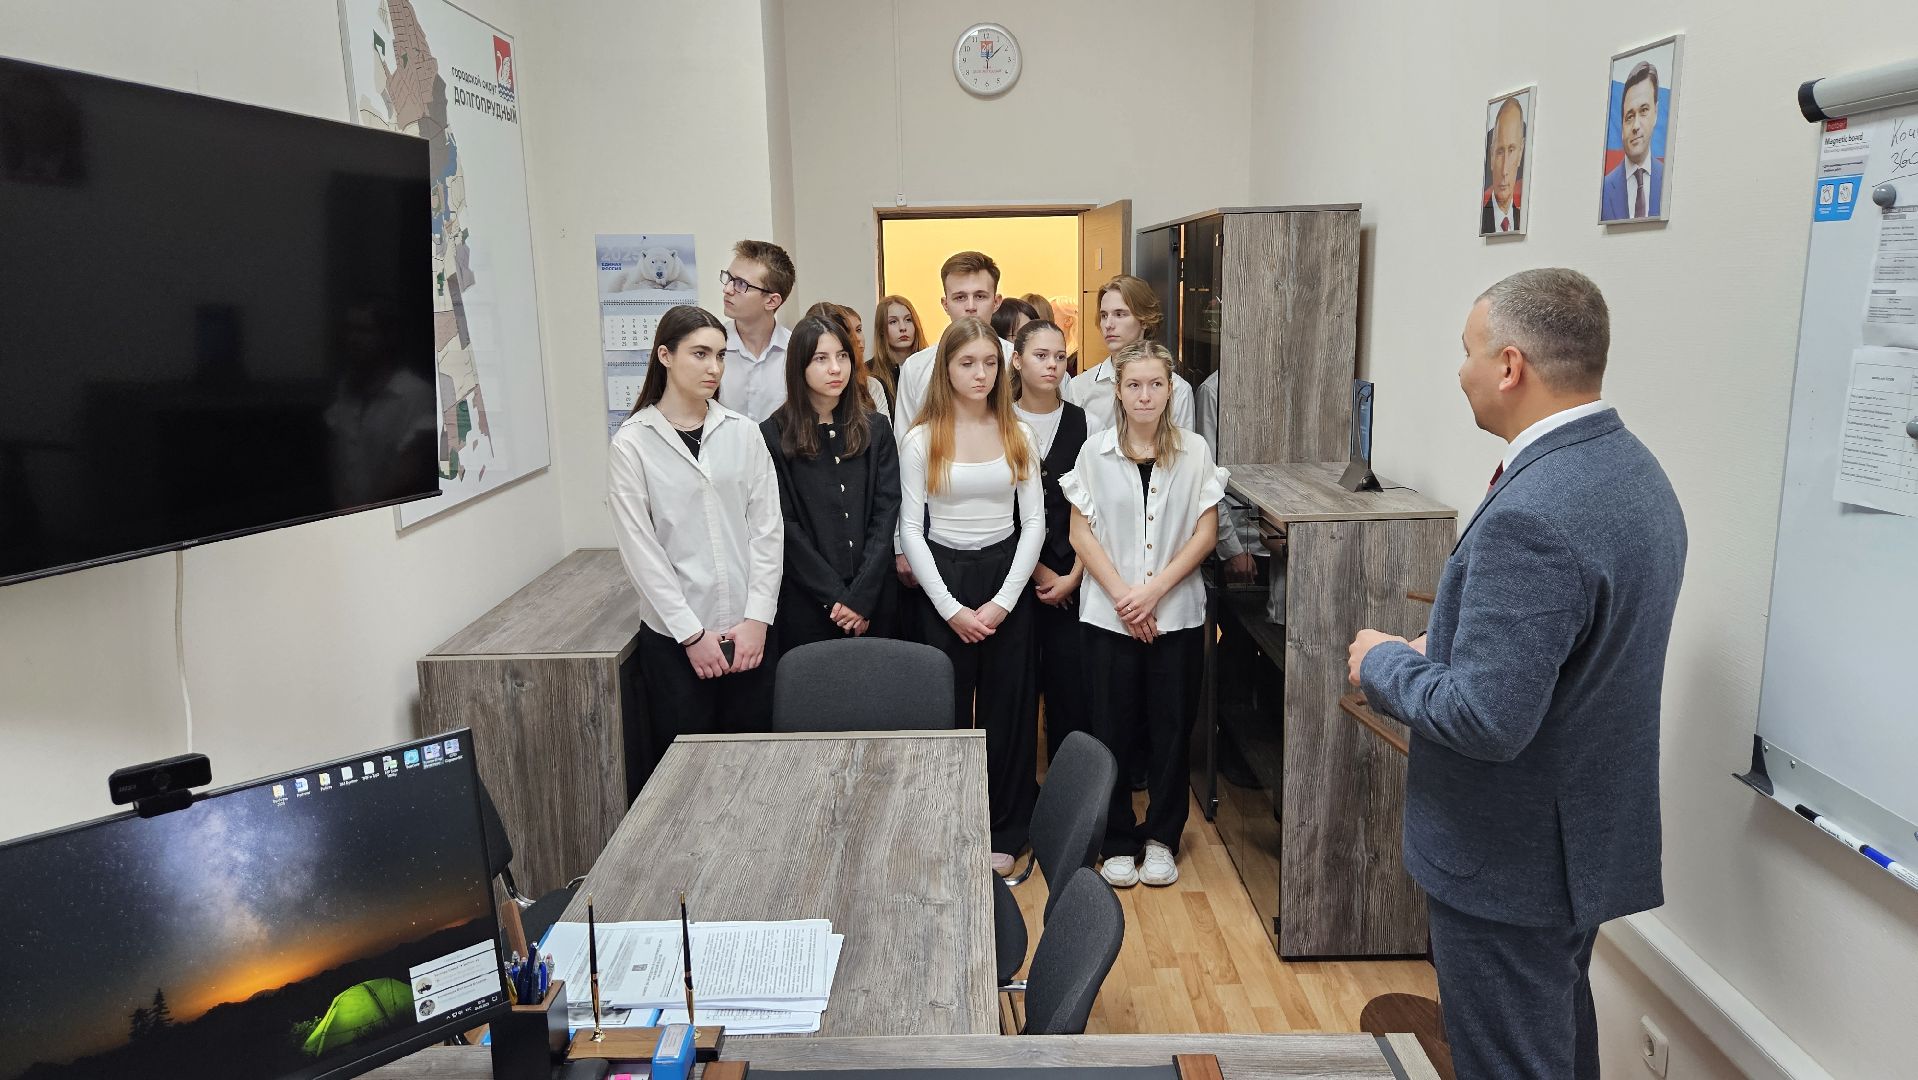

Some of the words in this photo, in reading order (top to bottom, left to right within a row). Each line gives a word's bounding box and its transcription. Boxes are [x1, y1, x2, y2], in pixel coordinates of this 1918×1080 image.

[451, 67, 482, 87] городской
[482, 80, 497, 95] округ
[454, 86, 518, 125] ДОЛГОПРУДНЫЙ
[1824, 135, 1848, 147] Magnetic
[1848, 132, 1864, 142] board
